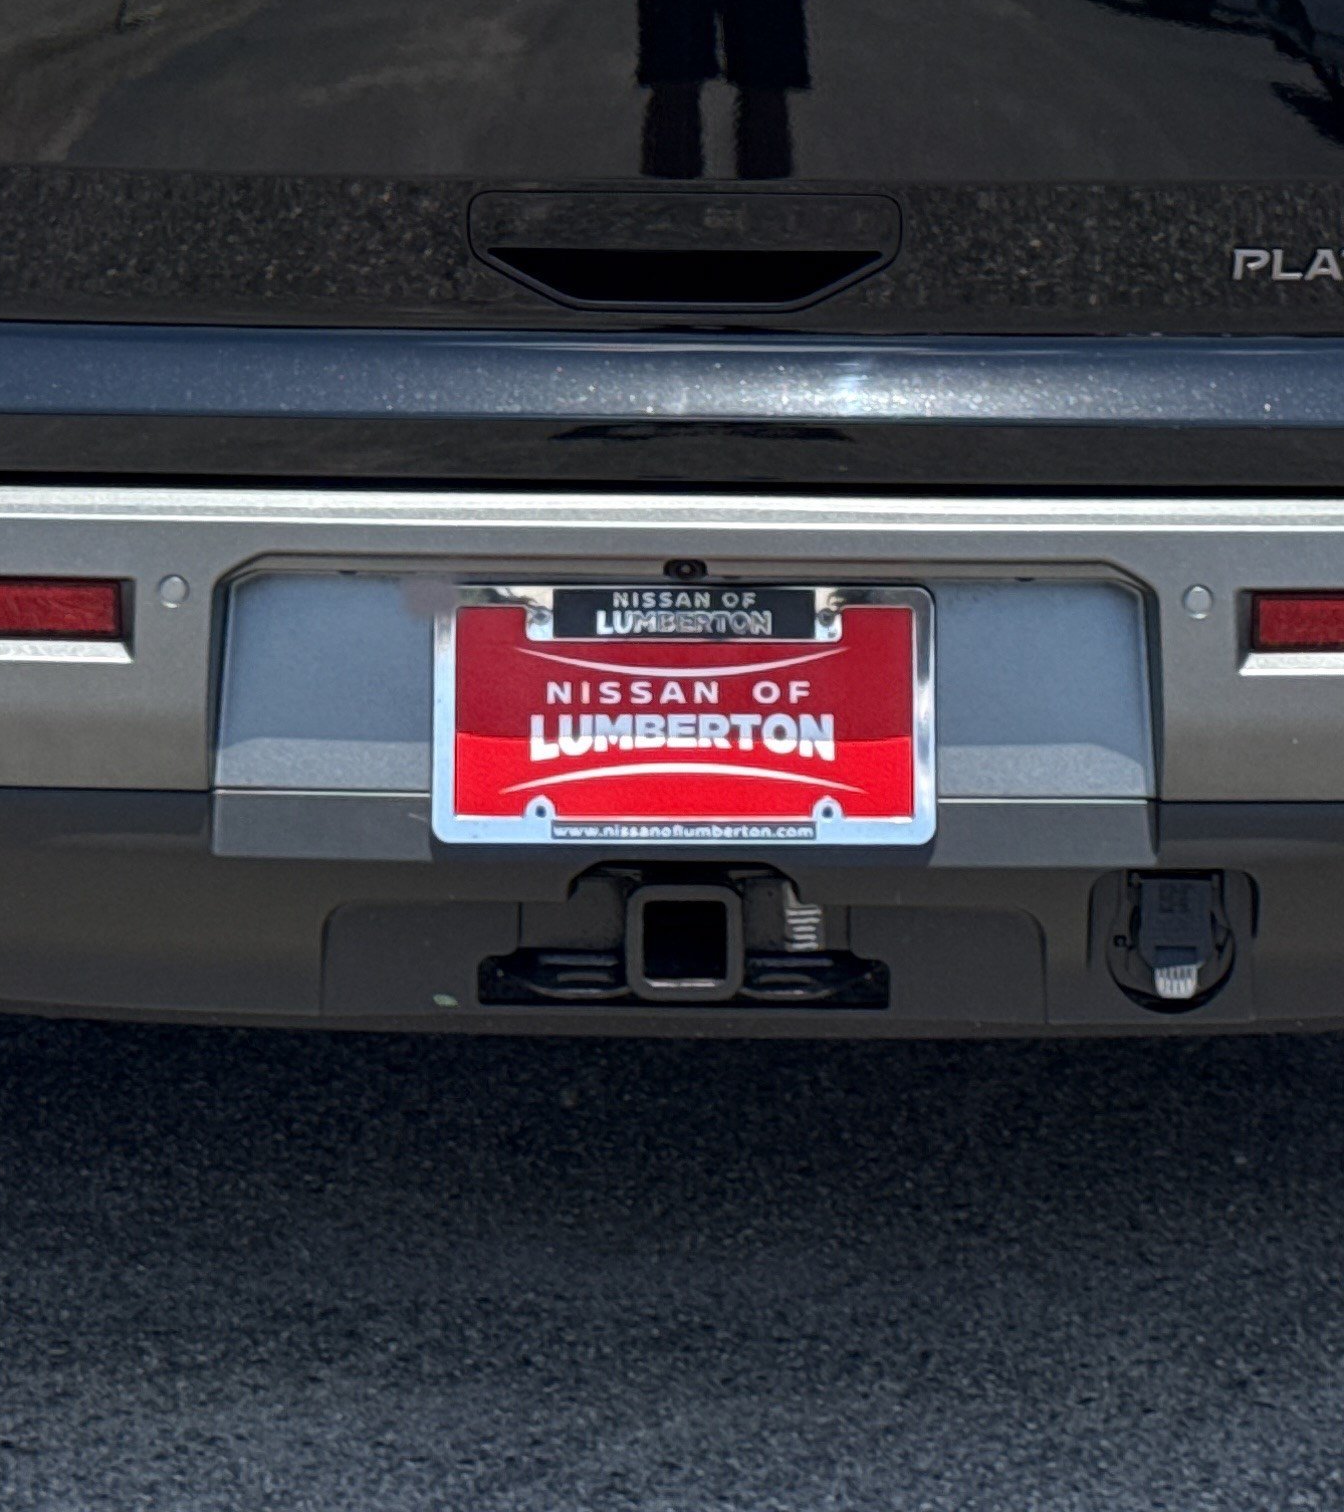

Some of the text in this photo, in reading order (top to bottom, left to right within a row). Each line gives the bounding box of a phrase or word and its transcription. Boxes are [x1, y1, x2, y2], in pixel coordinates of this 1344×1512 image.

[612, 591, 757, 609] NISSAN OF
[596, 610, 773, 635] LUMBERTON
[547, 681, 812, 705] NISSAN OF
[529, 713, 836, 762] LUMBERTON
[552, 823, 815, 839] www.nissanoflumberton.com
